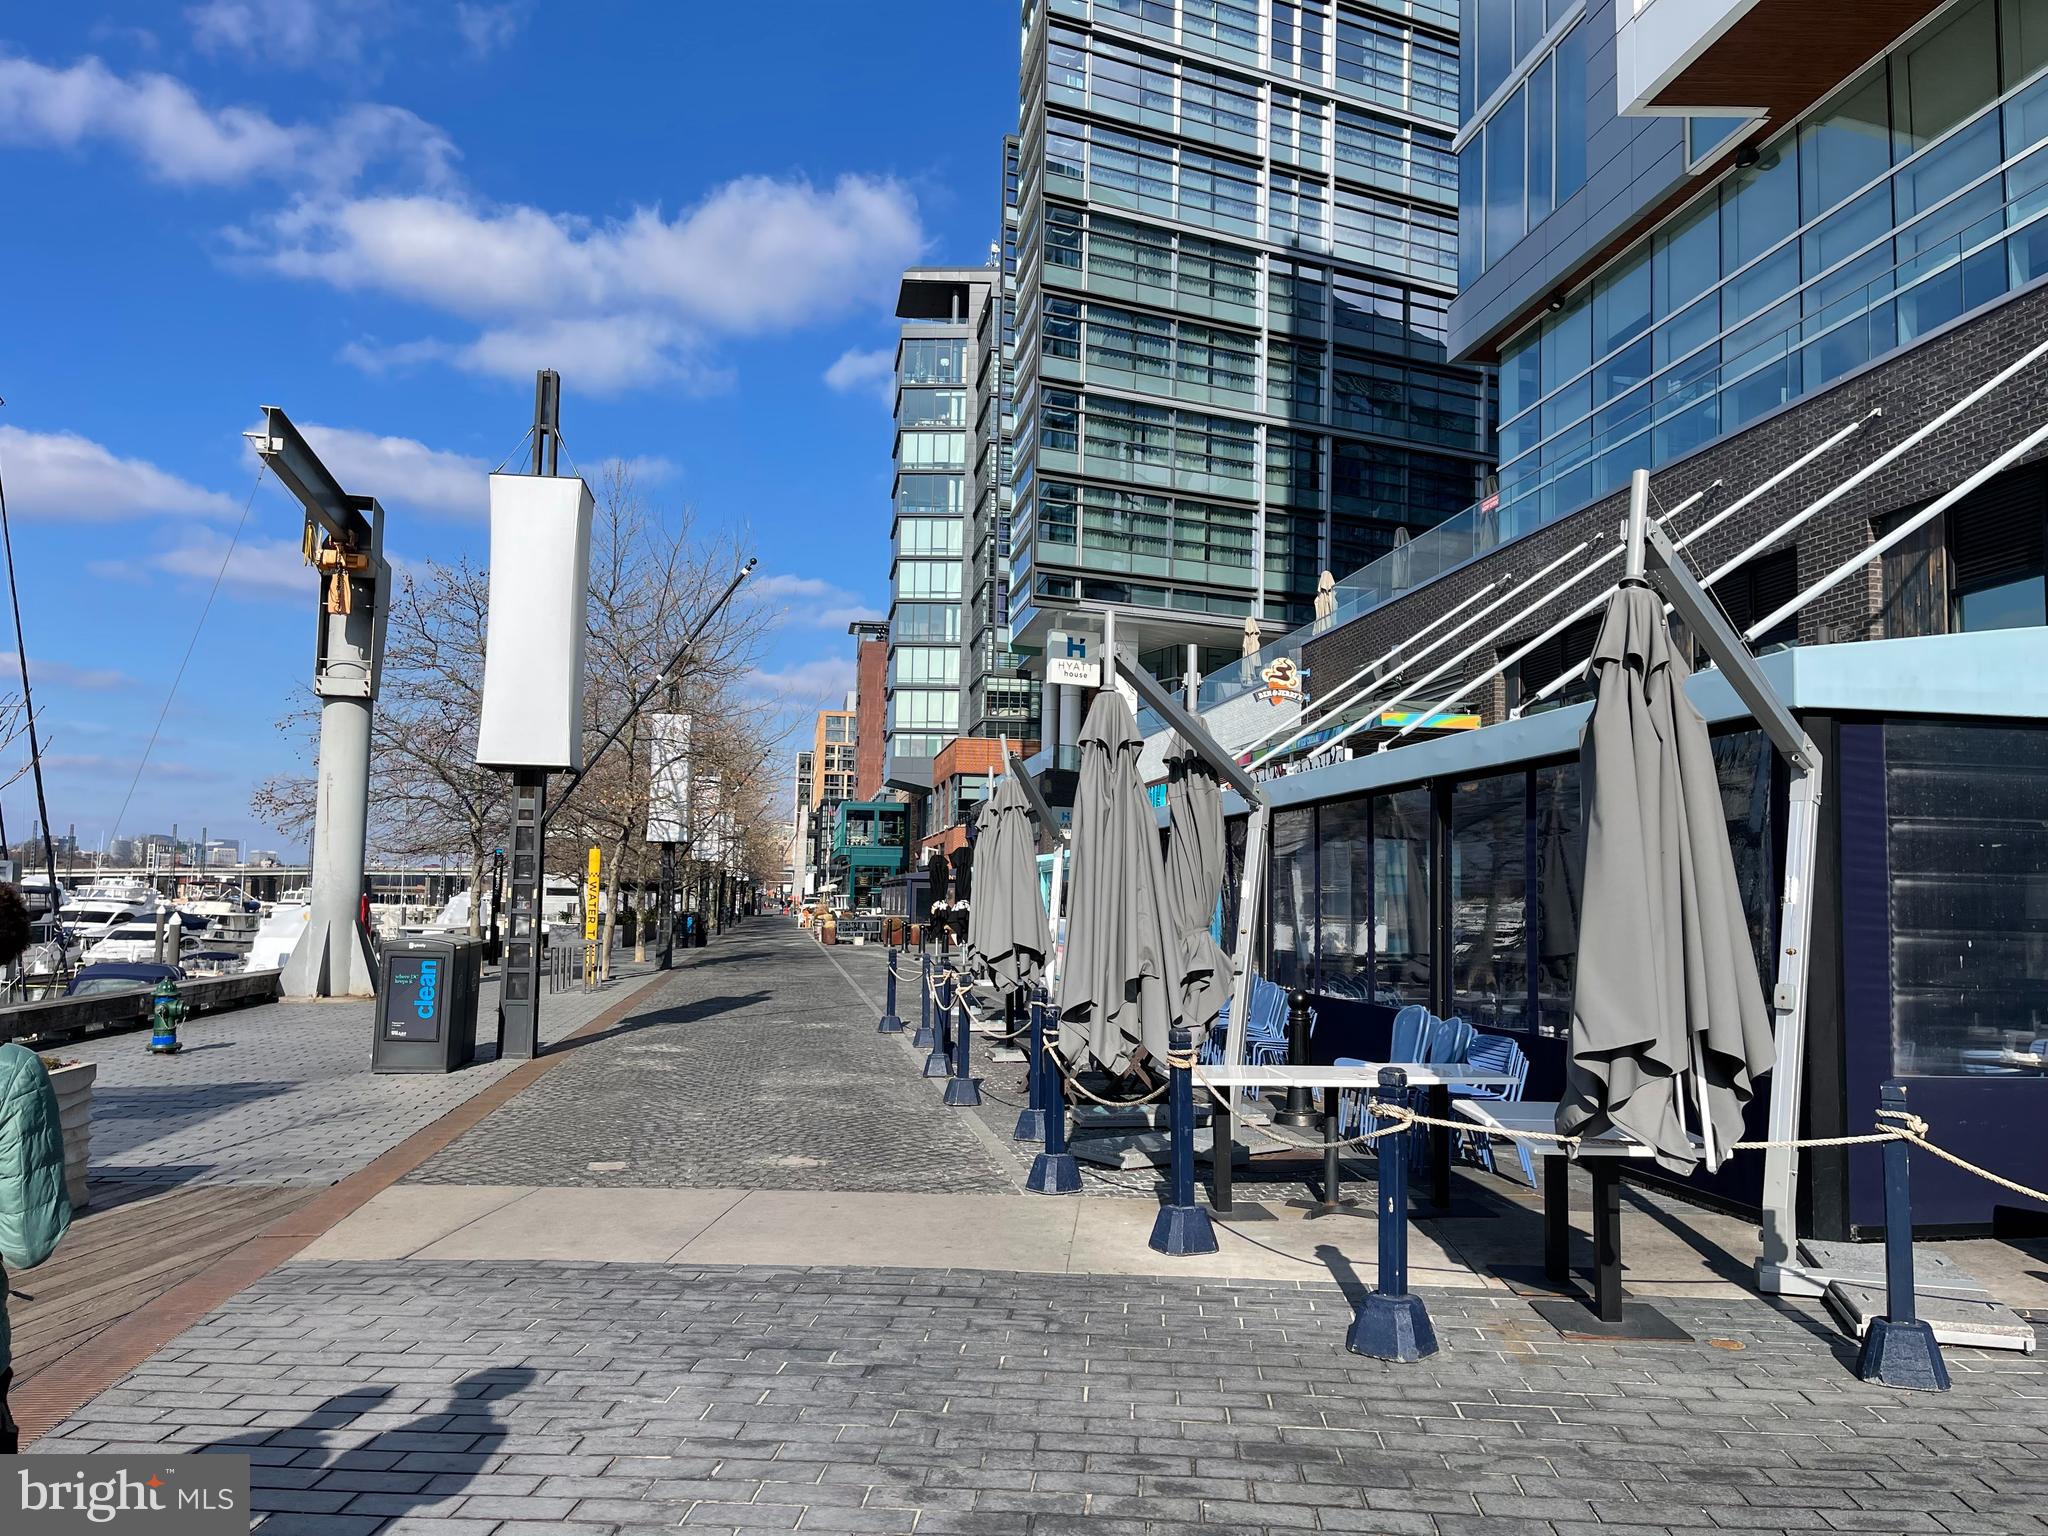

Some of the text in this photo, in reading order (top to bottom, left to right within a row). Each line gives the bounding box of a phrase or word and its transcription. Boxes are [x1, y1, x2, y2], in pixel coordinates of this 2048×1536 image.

[1058, 661, 1093, 672] HYATT
[1063, 670, 1088, 679] house
[587, 881, 597, 924] WATER
[414, 961, 437, 1019] clean
